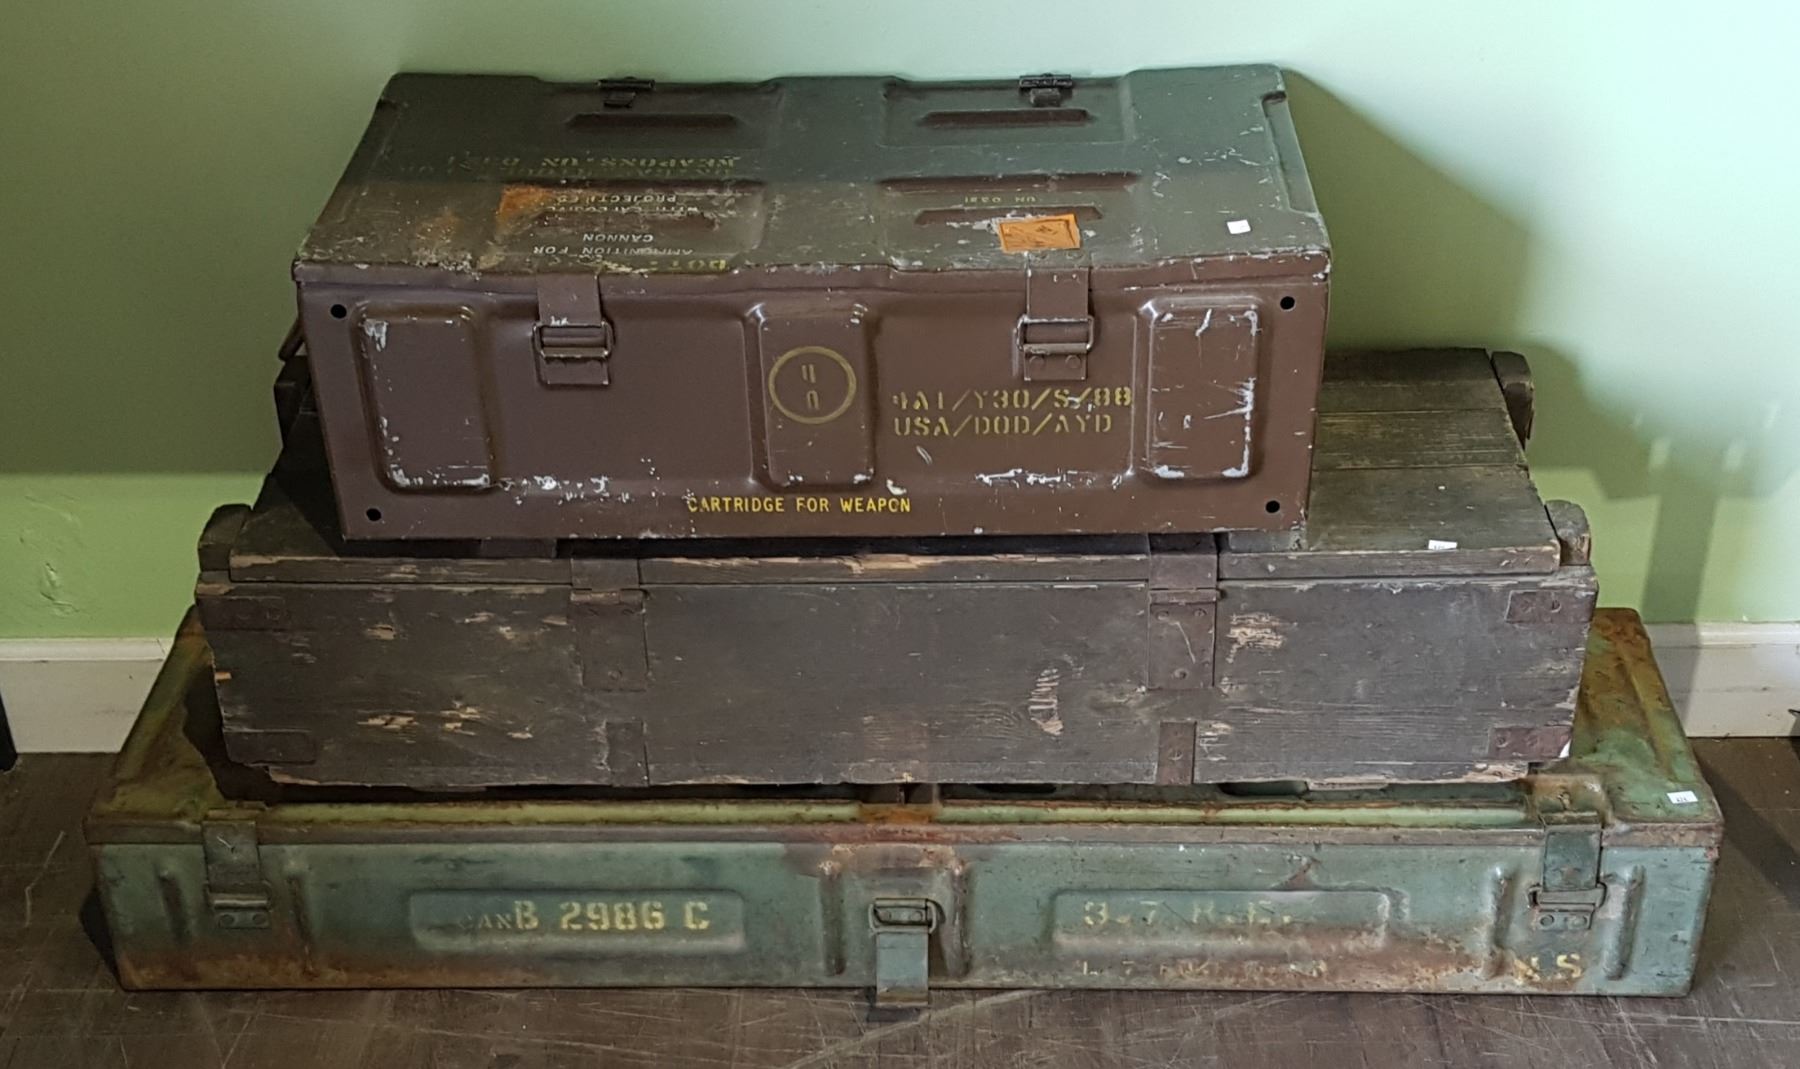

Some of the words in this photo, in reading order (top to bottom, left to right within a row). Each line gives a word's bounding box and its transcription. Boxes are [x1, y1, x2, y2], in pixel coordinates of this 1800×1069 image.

[582, 233, 654, 243] CANNON
[532, 245, 570, 256] FOR
[893, 412, 1112, 438] USA/DOD/AYD
[686, 497, 785, 513] CARTRIDGE
[795, 497, 830, 513] FOR
[839, 497, 912, 513] WEAPON
[559, 901, 666, 931] 2986
[684, 900, 711, 931] C
